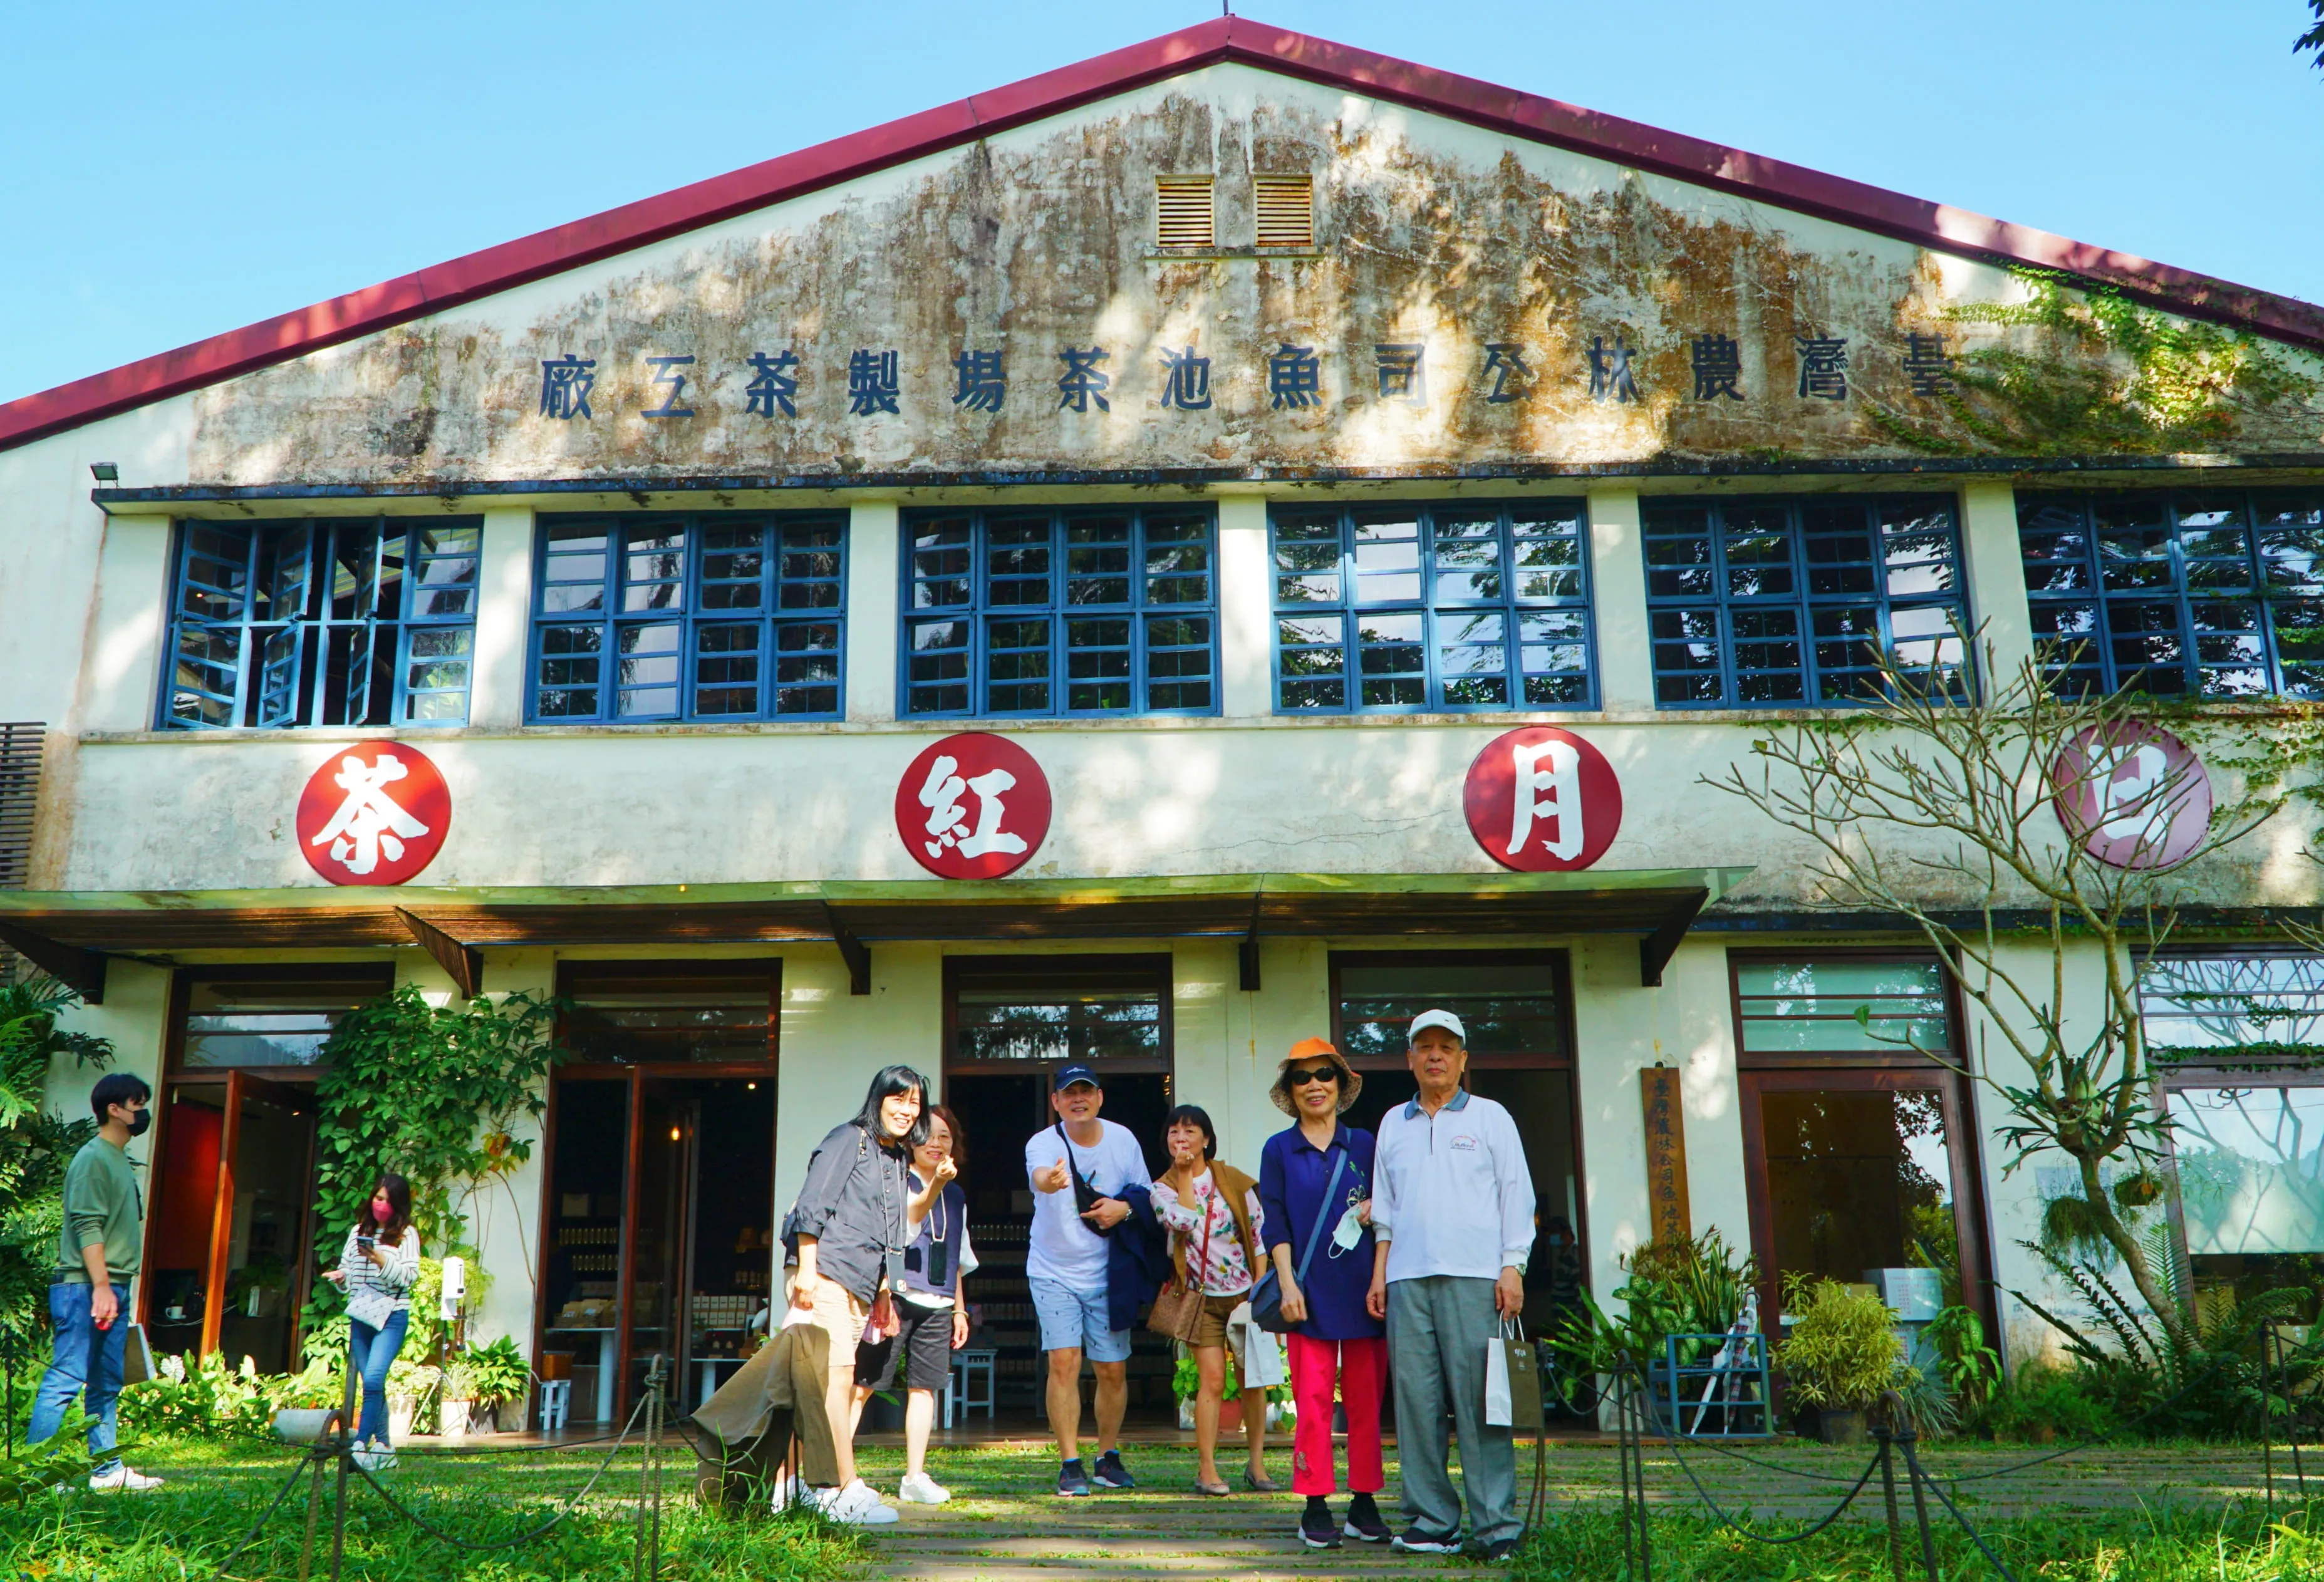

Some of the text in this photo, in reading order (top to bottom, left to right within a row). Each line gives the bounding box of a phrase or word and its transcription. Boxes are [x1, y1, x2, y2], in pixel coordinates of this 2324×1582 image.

[312, 740, 2167, 874] 日 月 紅 茶
